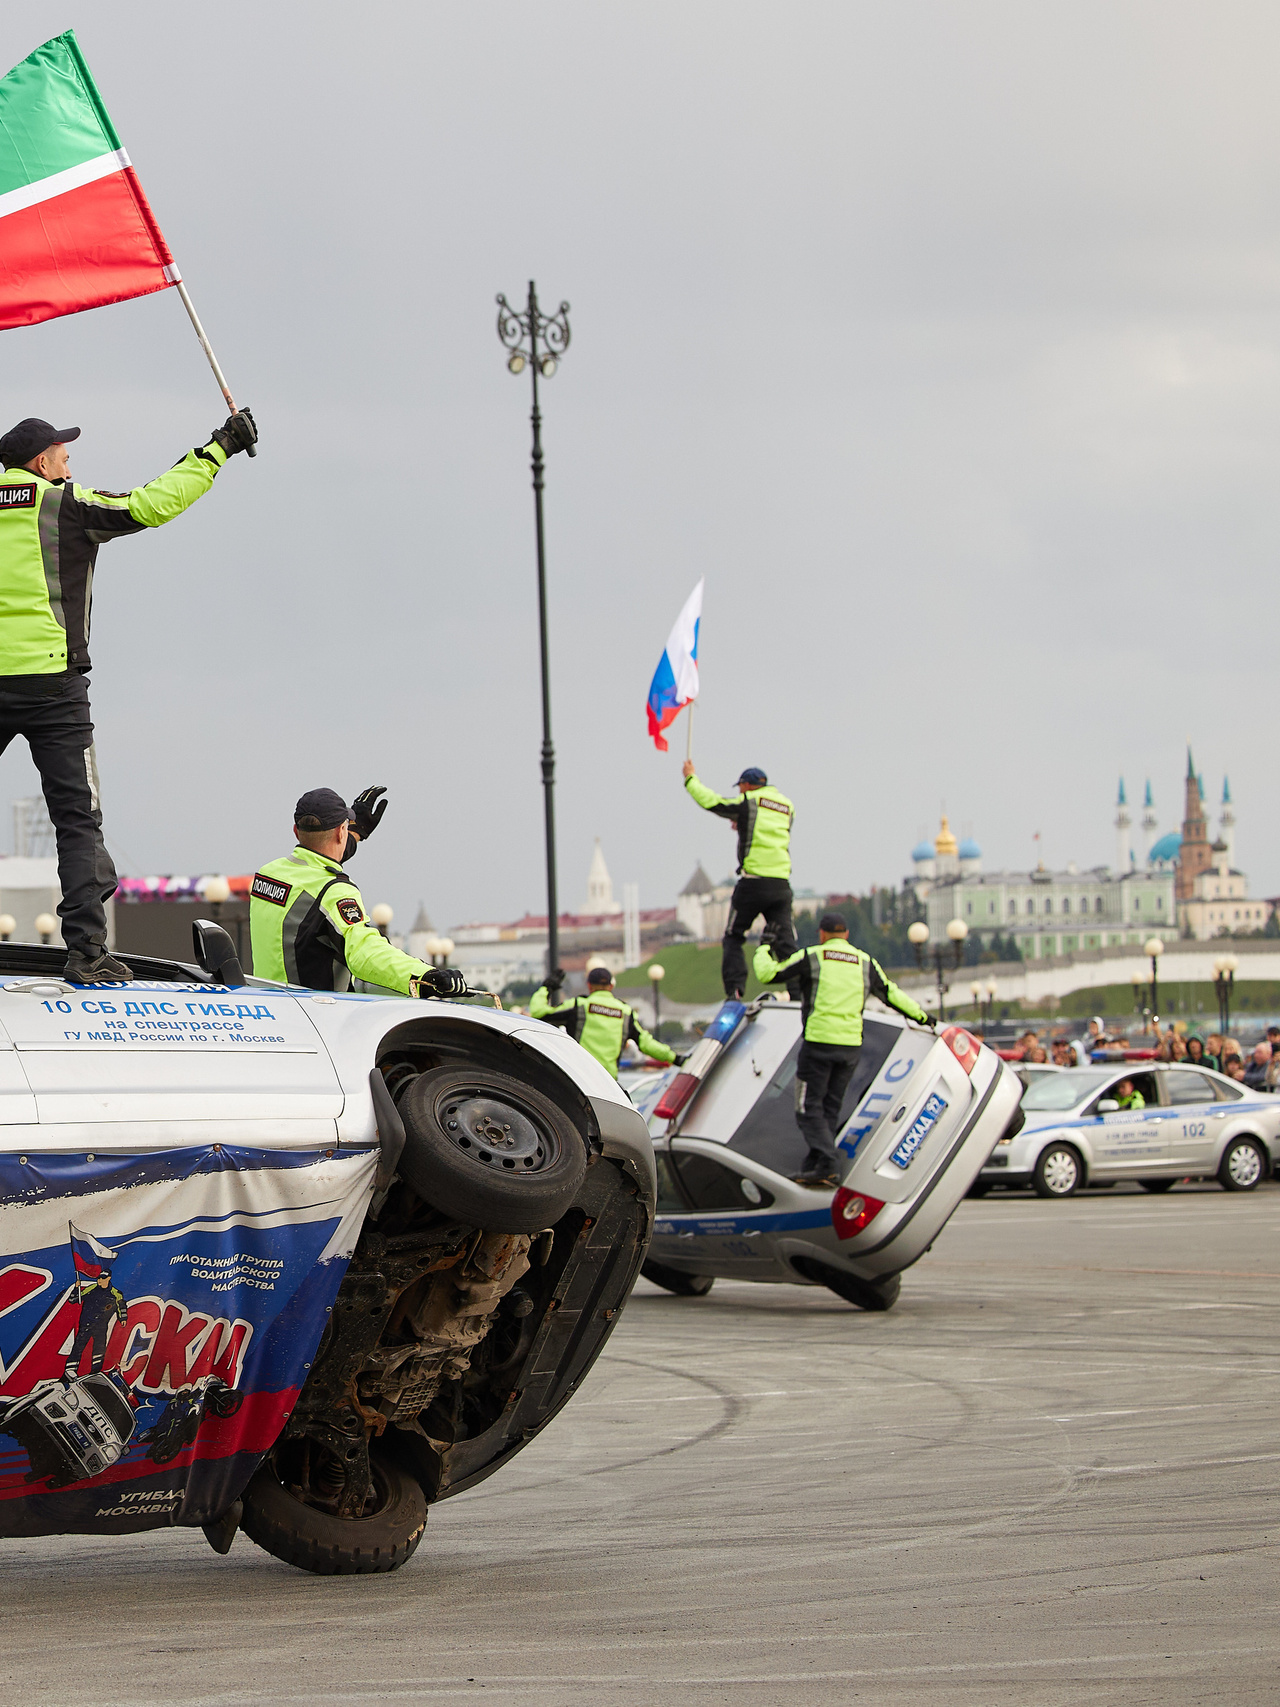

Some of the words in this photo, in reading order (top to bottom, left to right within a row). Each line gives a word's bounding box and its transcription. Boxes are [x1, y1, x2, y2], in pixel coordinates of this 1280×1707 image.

[253, 879, 286, 900] ПОЛИЦИЯ
[40, 1000, 71, 1014] 10
[81, 1001, 117, 1014] СБ
[125, 1001, 179, 1017] ДПС
[185, 1003, 276, 1020] ГИБДД
[104, 1020, 127, 1029] на
[134, 1020, 245, 1032] спецтрассе
[64, 1031, 81, 1041] ГУ
[87, 1031, 125, 1043] МВД
[128, 1032, 184, 1043] России
[189, 1034, 206, 1042] по
[213, 1034, 225, 1042] г.
[229, 1033, 286, 1043] Москве
[838, 1058, 915, 1159] ДПС
[1182, 1123, 1206, 1138] 102
[169, 1253, 240, 1268] ПИЛОТАЖНАЯ
[240, 1254, 284, 1268] ГРУППА
[190, 1265, 280, 1280] ВОДИТЕЛЬСКОГО
[211, 1276, 275, 1292] МАСТЕРСТВА
[83, 1406, 113, 1438] ДПС
[94, 1501, 179, 1517] МОСКВЫ
